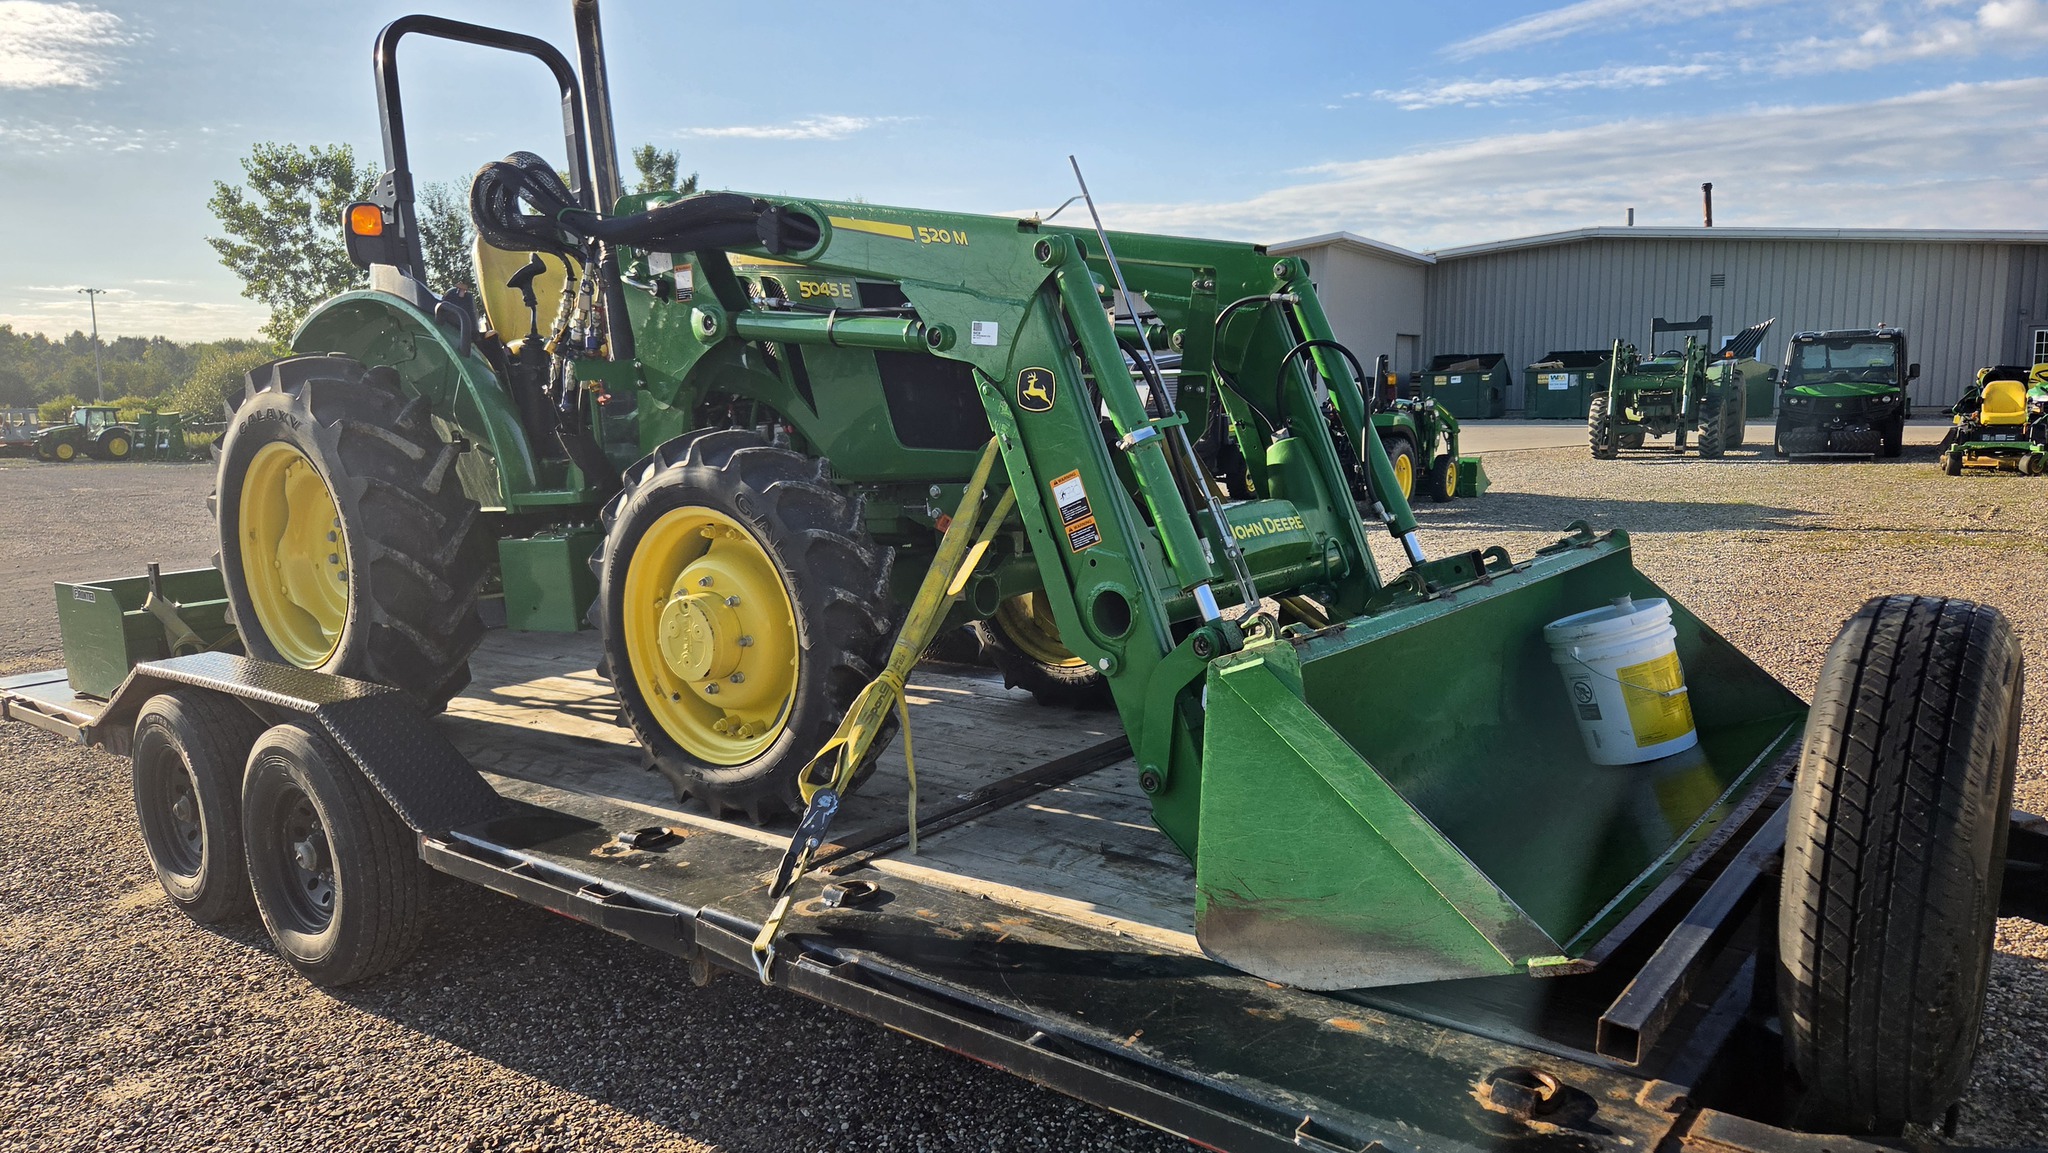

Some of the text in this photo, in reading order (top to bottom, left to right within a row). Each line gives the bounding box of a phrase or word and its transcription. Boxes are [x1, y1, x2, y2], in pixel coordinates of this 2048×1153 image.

[917, 226, 969, 246] 520 M
[800, 281, 853, 298] 5045 E
[239, 408, 301, 435] GALAXY
[1230, 516, 1304, 539] JOHN DEERE
